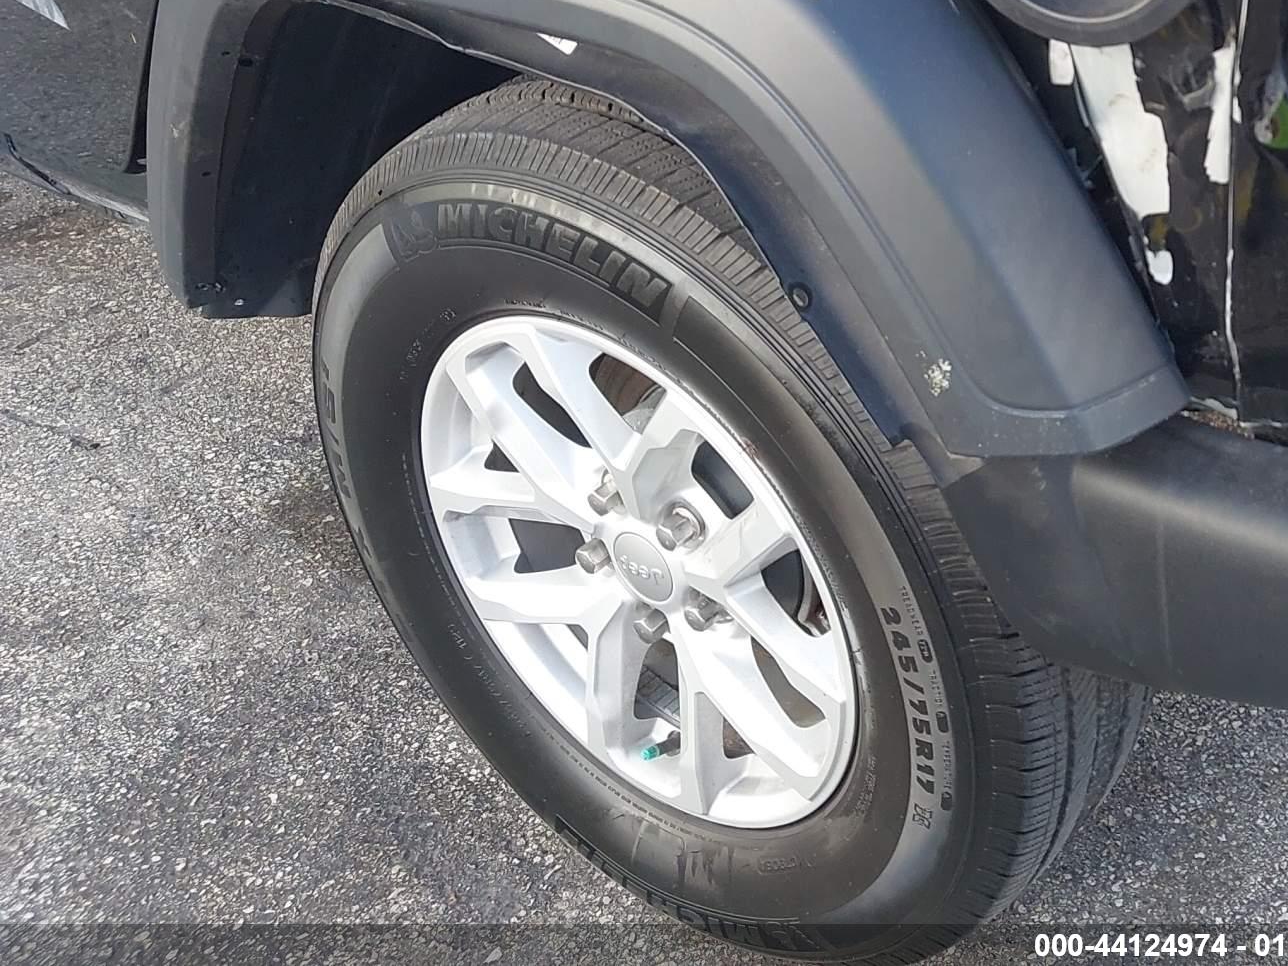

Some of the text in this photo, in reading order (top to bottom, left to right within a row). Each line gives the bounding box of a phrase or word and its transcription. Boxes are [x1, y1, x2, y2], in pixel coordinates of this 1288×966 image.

[437, 202, 670, 309] MICHELIN
[619, 554, 665, 587] Jeep
[880, 606, 935, 795] 245/75R17
